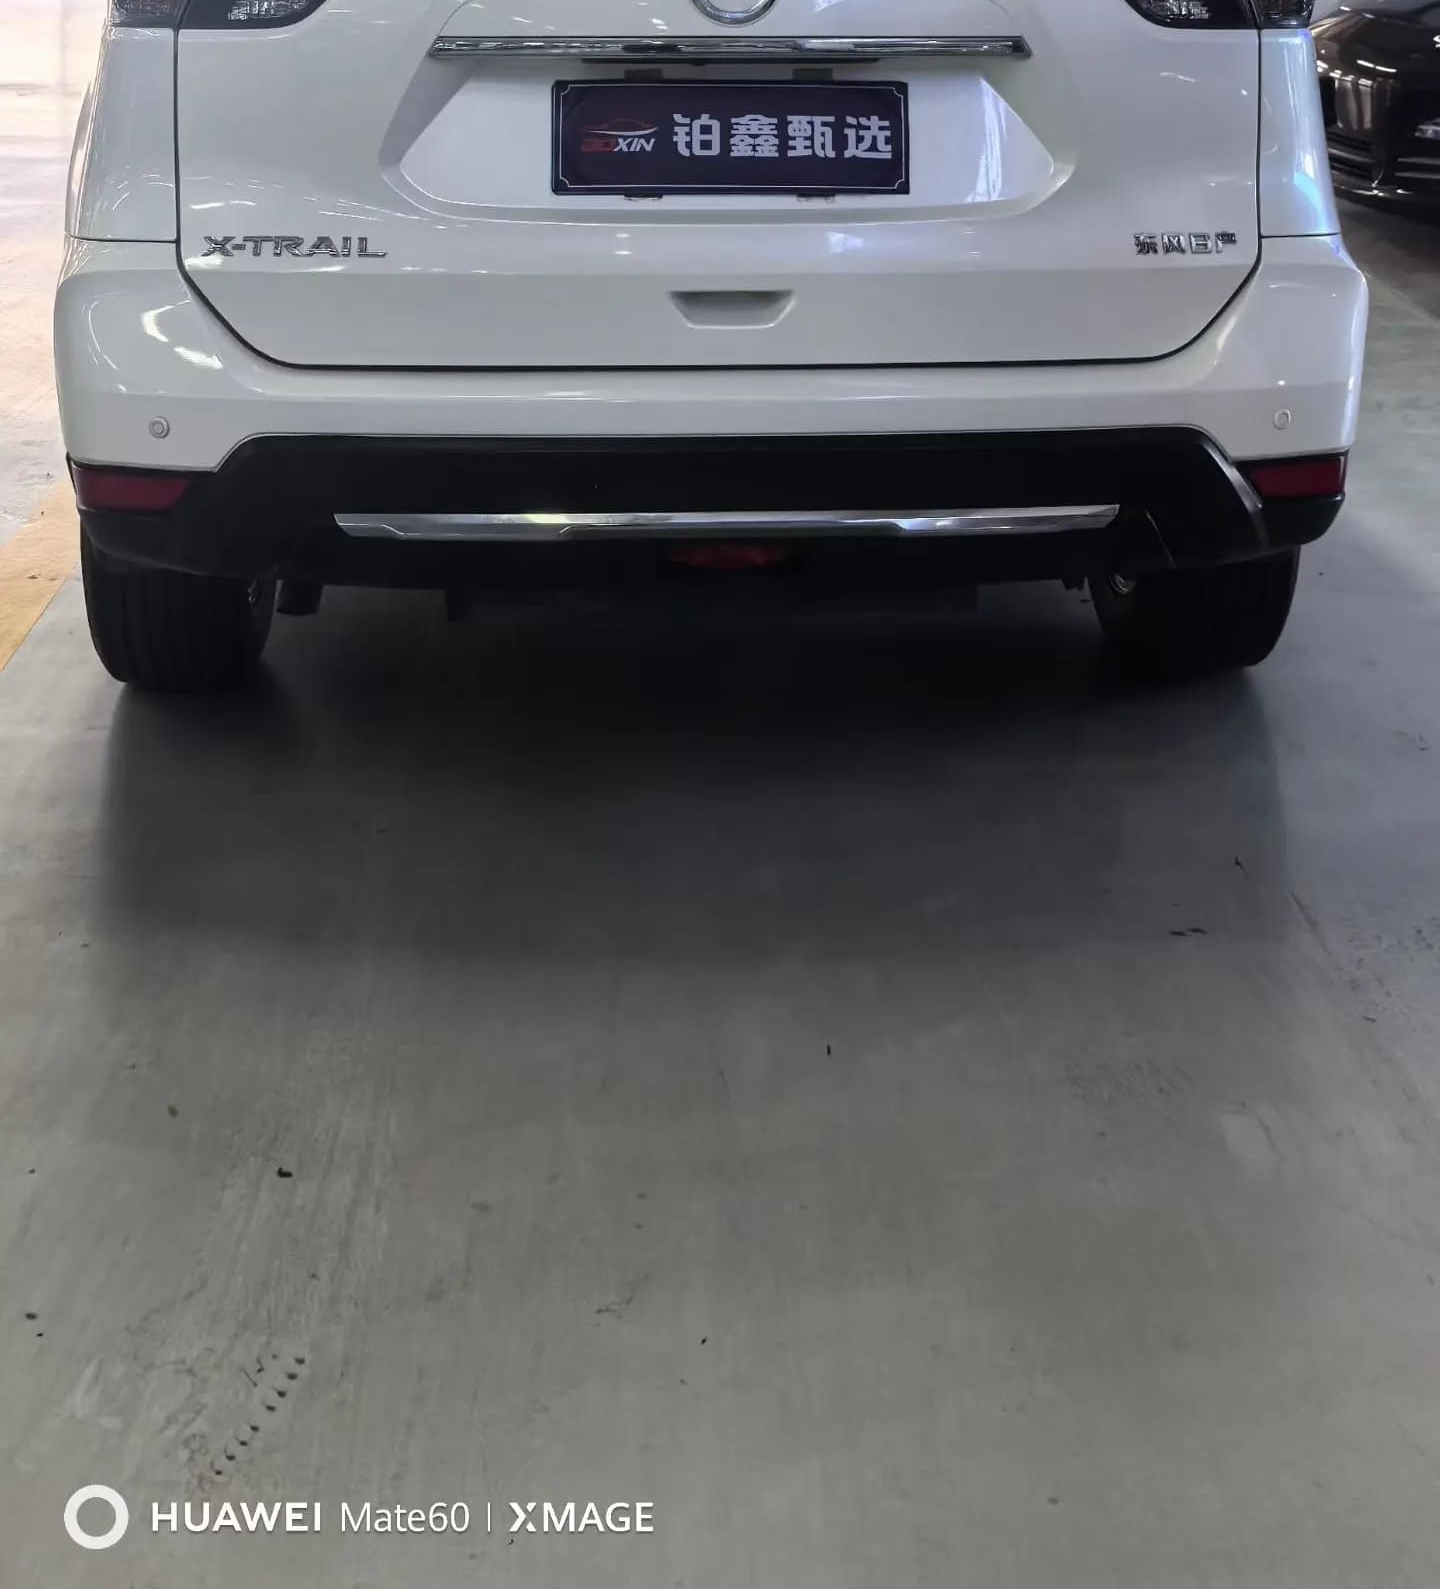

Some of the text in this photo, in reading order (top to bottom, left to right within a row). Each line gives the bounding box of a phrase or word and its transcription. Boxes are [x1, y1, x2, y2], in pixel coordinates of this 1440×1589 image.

[672, 113, 893, 159] 铂鑫甄选
[201, 235, 387, 257] X-TRAIL
